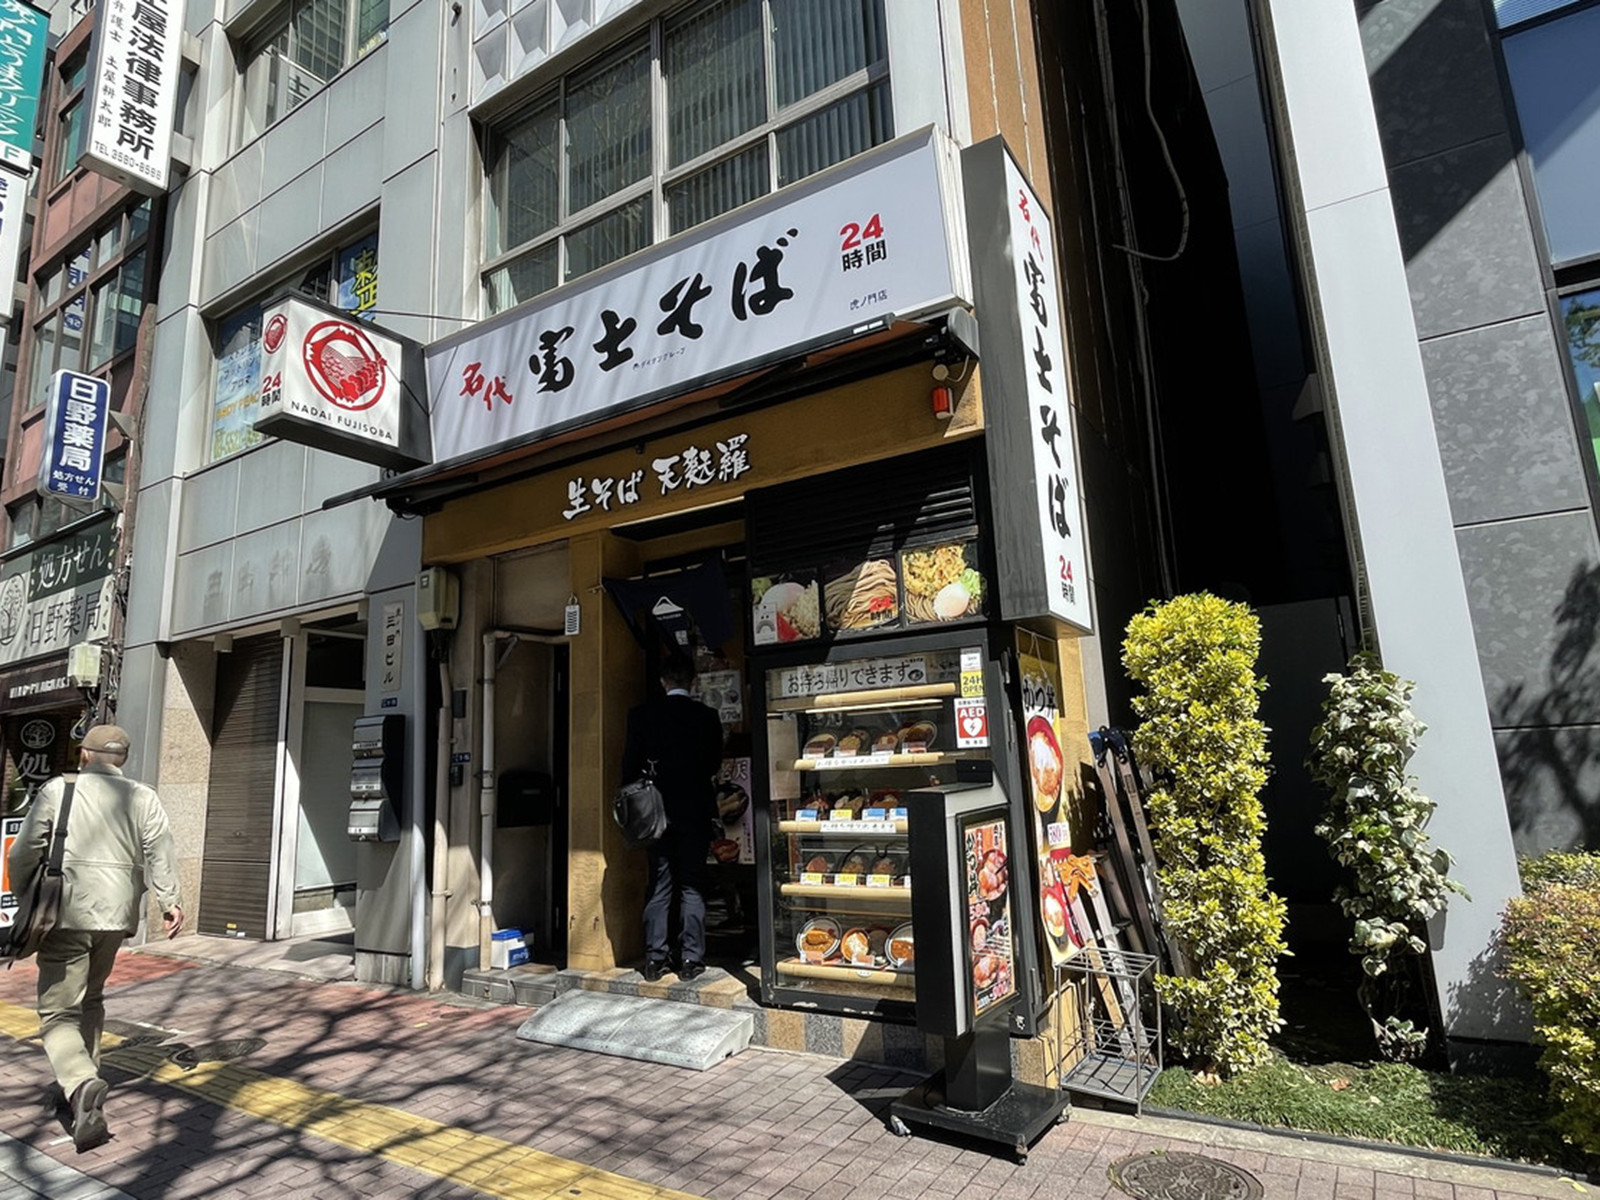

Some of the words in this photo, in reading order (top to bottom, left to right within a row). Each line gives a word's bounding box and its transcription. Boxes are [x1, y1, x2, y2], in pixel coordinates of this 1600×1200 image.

[94, 140, 110, 157] TEL
[840, 213, 885, 251] 24
[841, 239, 888, 272] 時間
[848, 288, 889, 312] 虎ノ門店
[263, 371, 282, 394] 24
[458, 361, 514, 412] 名代
[291, 400, 333, 423] NADAI
[337, 415, 393, 441] FUJISOBA
[52, 469, 96, 487] 処方せん
[561, 470, 644, 520] 生そば
[36, 534, 107, 592] 処方せん
[1058, 553, 1074, 582] 24
[30, 589, 102, 646] 日野薬局
[869, 596, 893, 611] 24
[787, 662, 911, 695] お持ち帰りできます
[962, 675, 984, 686] 24H
[962, 684, 985, 693] OPEN
[959, 707, 985, 718] AED
